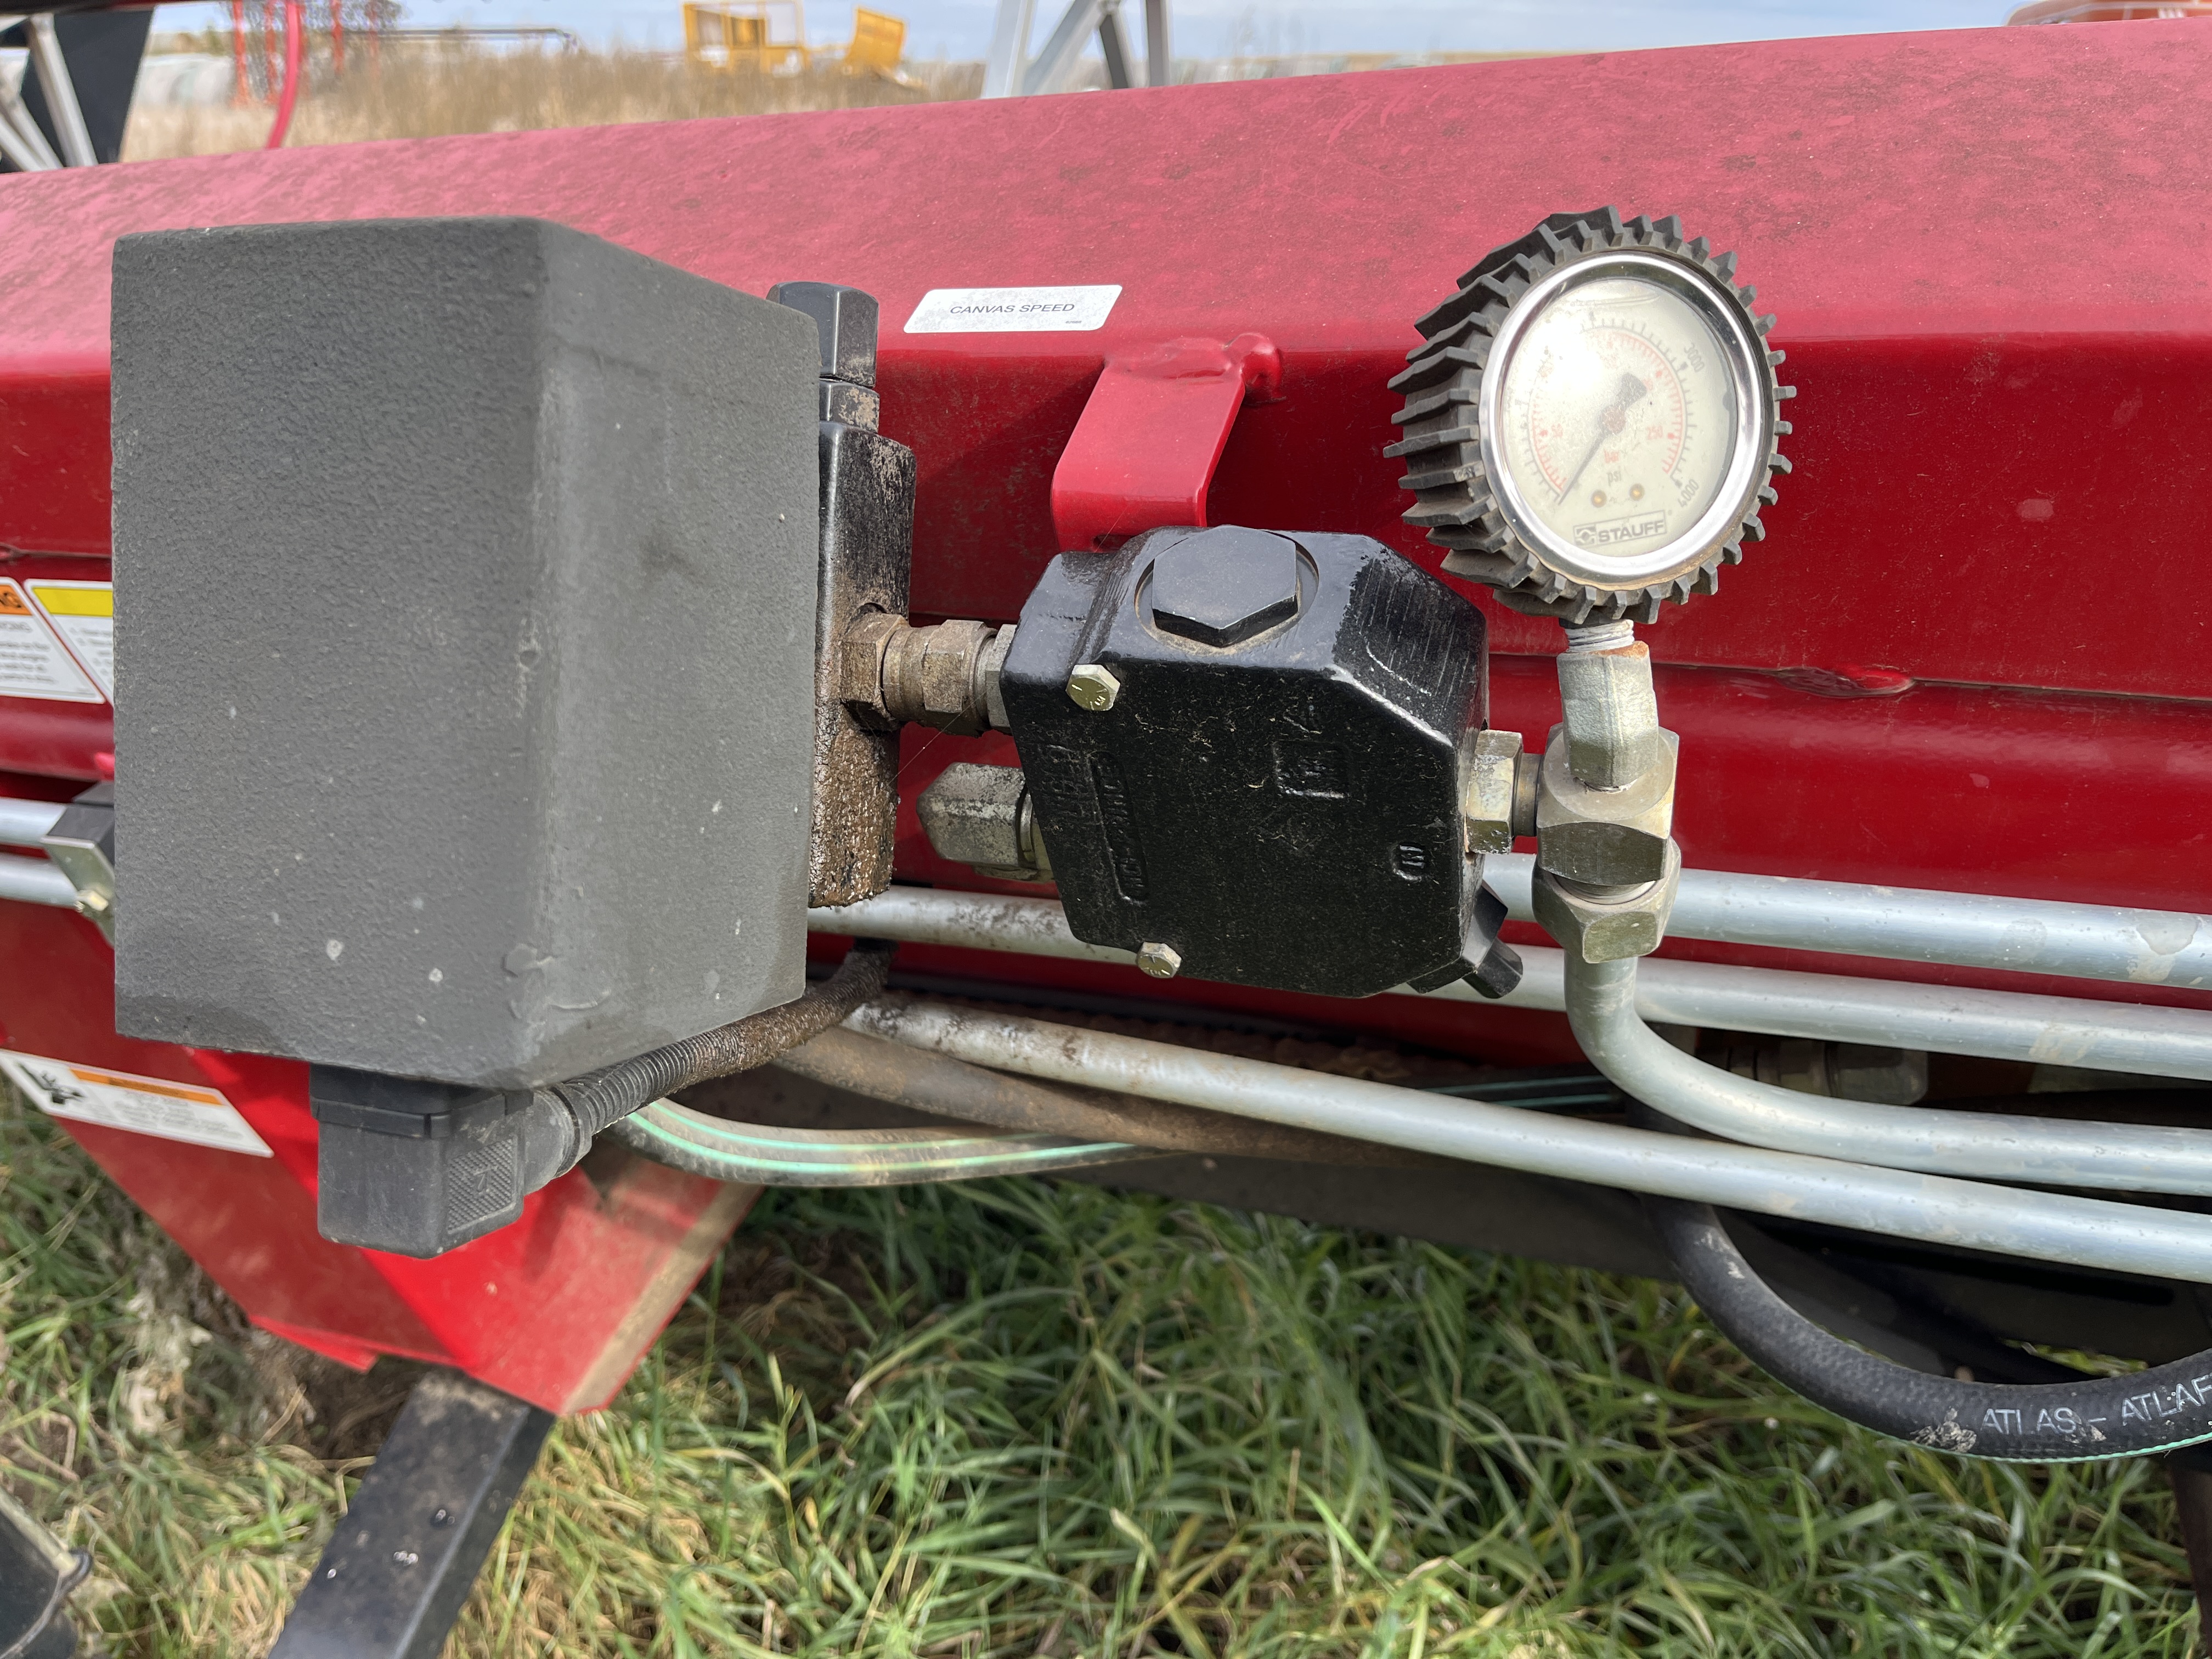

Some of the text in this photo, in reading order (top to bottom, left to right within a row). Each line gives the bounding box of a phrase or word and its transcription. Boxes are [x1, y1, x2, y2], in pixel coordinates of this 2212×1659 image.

[950, 303, 1075, 314] CANVAS SPEED
[1684, 342, 1705, 373] 3000
[1606, 465, 1622, 487] psi
[1677, 478, 1699, 508] 4000
[1598, 519, 1664, 543] STAUFF
[2121, 1372, 2212, 1426] ATLAF
